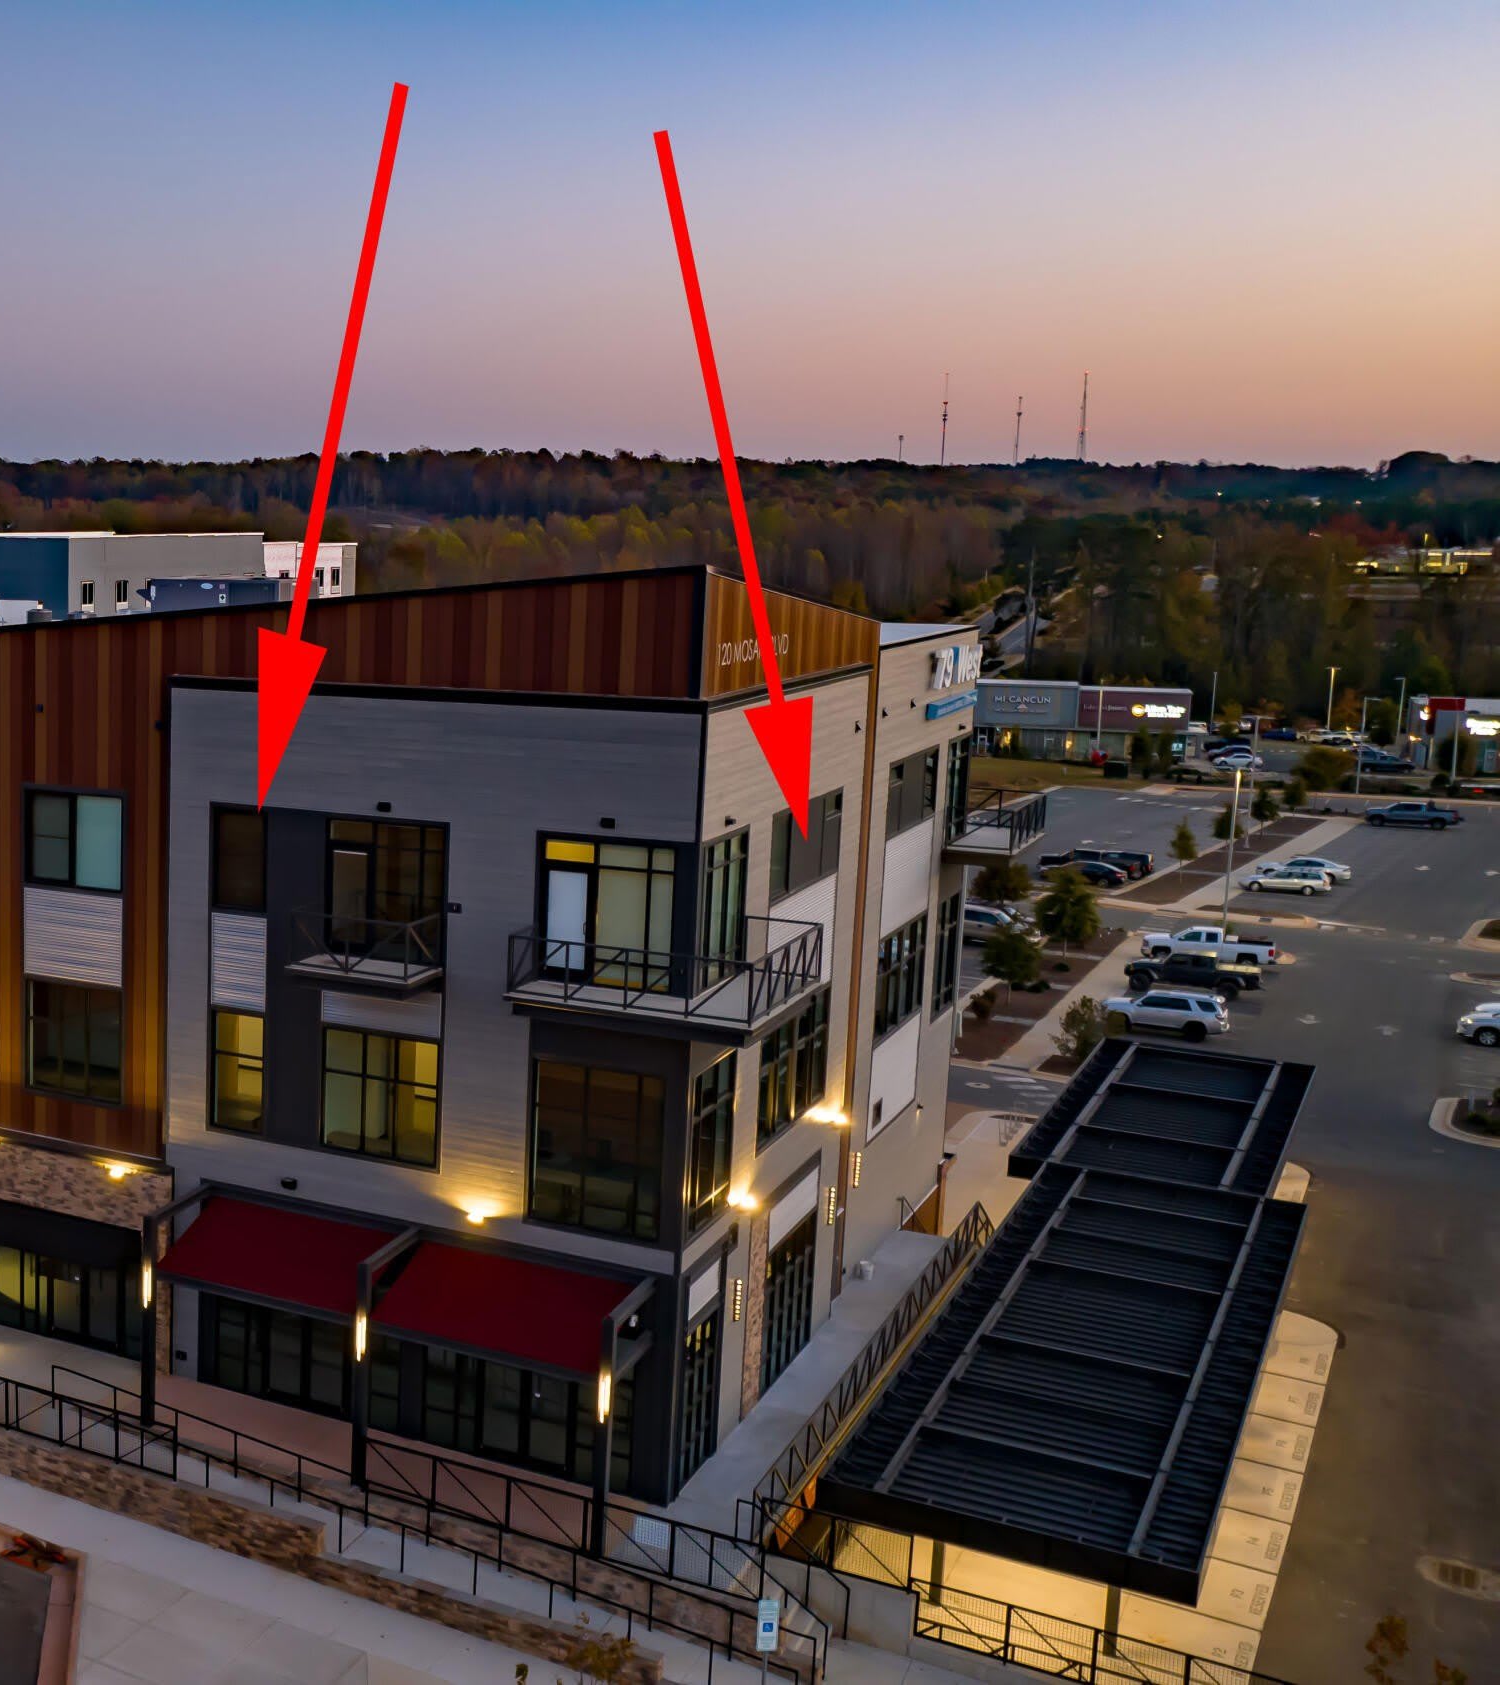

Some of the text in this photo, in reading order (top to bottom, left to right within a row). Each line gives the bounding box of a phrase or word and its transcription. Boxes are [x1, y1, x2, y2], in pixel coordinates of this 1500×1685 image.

[717, 633, 789, 666] 120 MOSA LVD
[933, 644, 984, 689] 79 West
[994, 695, 1051, 704] MI CANCUN
